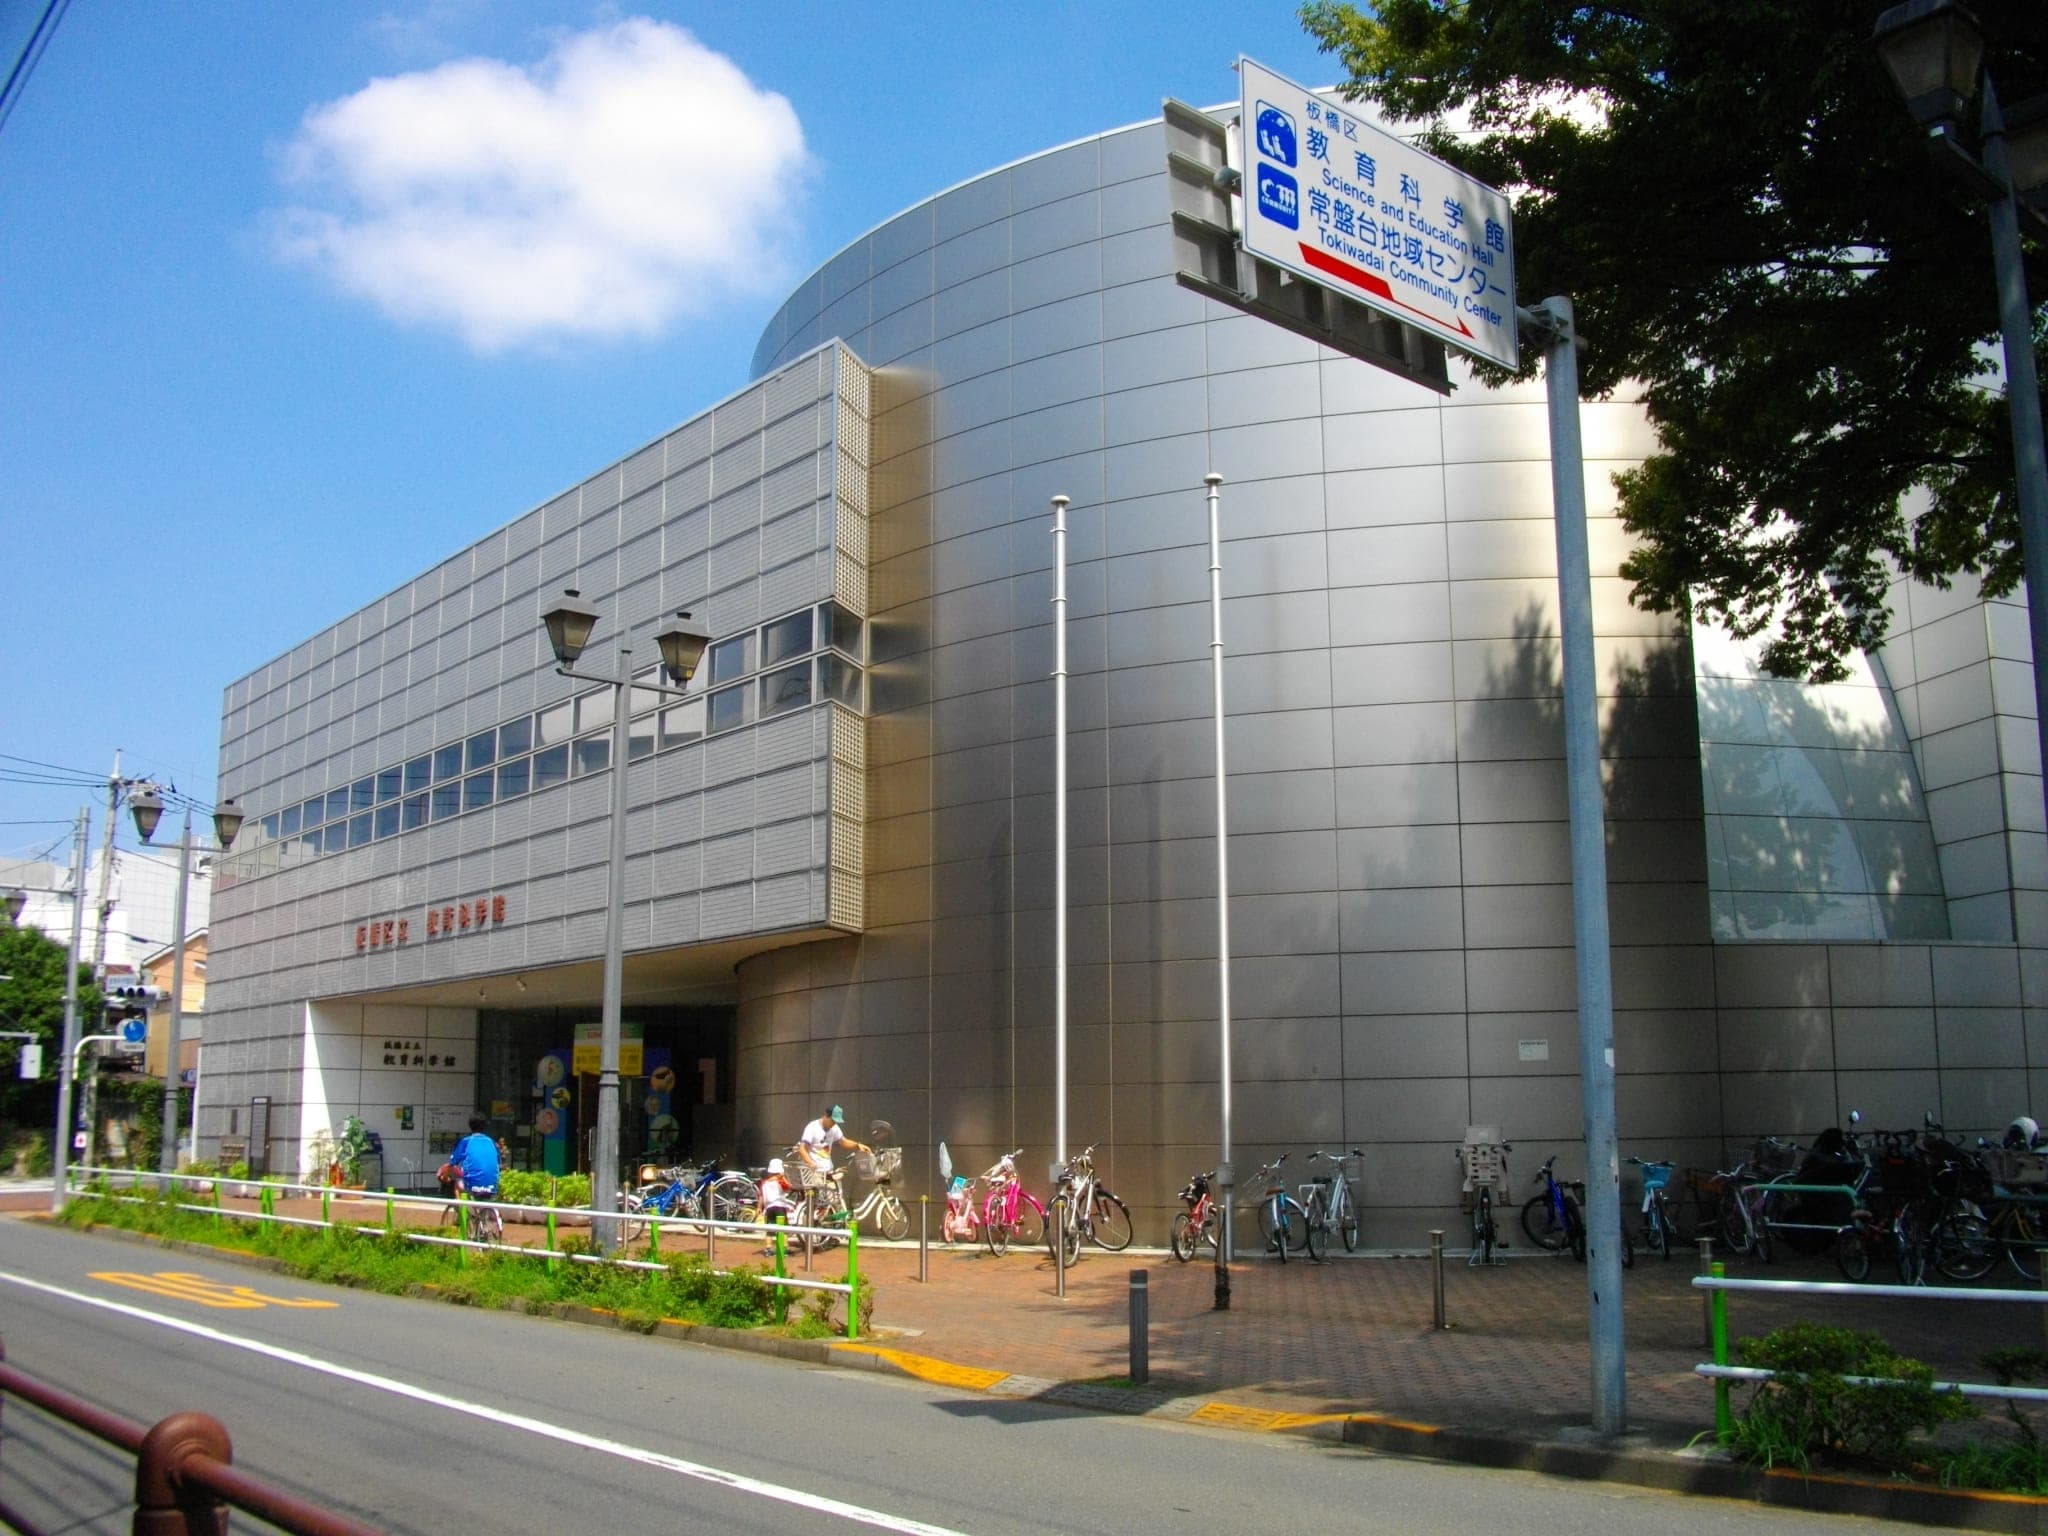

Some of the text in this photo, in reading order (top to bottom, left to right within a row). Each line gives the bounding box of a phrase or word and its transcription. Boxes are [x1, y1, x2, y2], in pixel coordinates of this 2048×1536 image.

[1306, 99, 1358, 143] 板橋区
[1306, 126, 1505, 253] 教育科学館
[1322, 167, 1495, 268] Science and Education Hall
[1308, 186, 1506, 295] 常盤台地域センター
[1318, 225, 1503, 326] Tokiwadai Community Center
